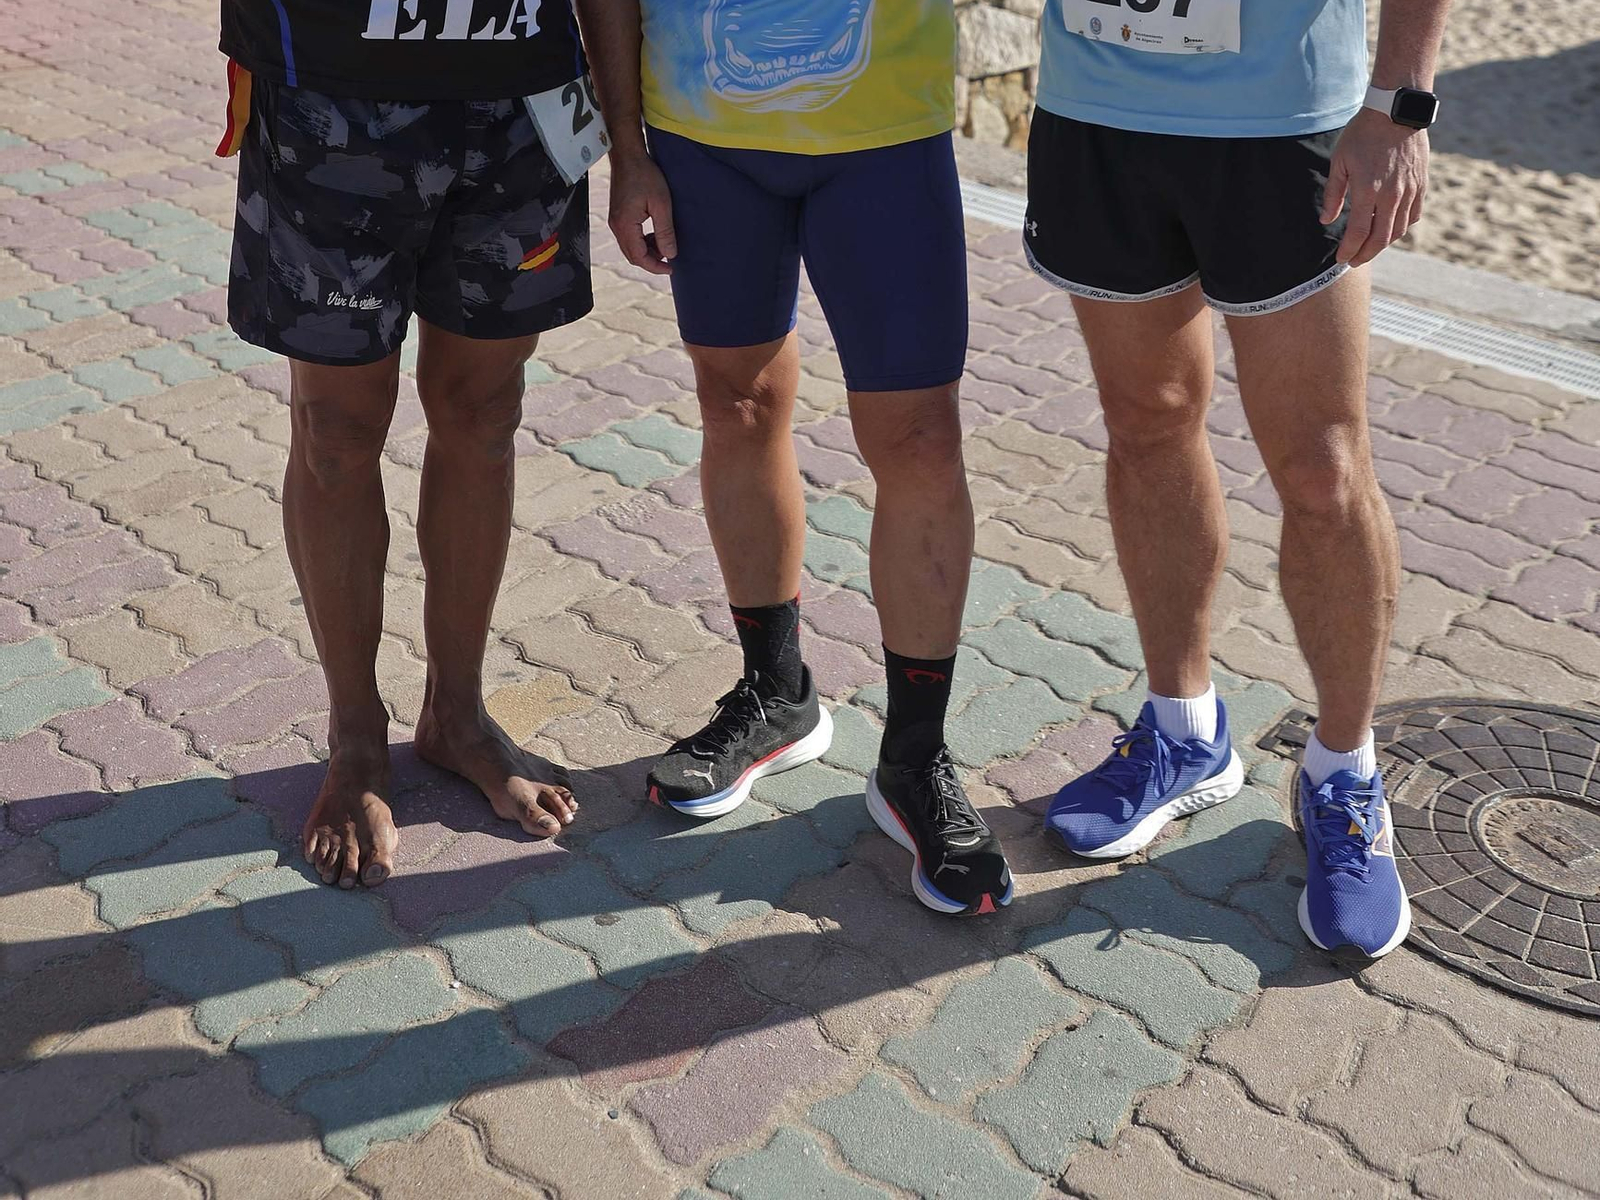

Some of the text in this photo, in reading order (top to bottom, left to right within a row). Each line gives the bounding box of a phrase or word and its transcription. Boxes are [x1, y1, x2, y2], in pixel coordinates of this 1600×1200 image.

[1317, 270, 1336, 287] RUN
[1090, 290, 1112, 299] RUN
[1249, 304, 1266, 313] RUN
